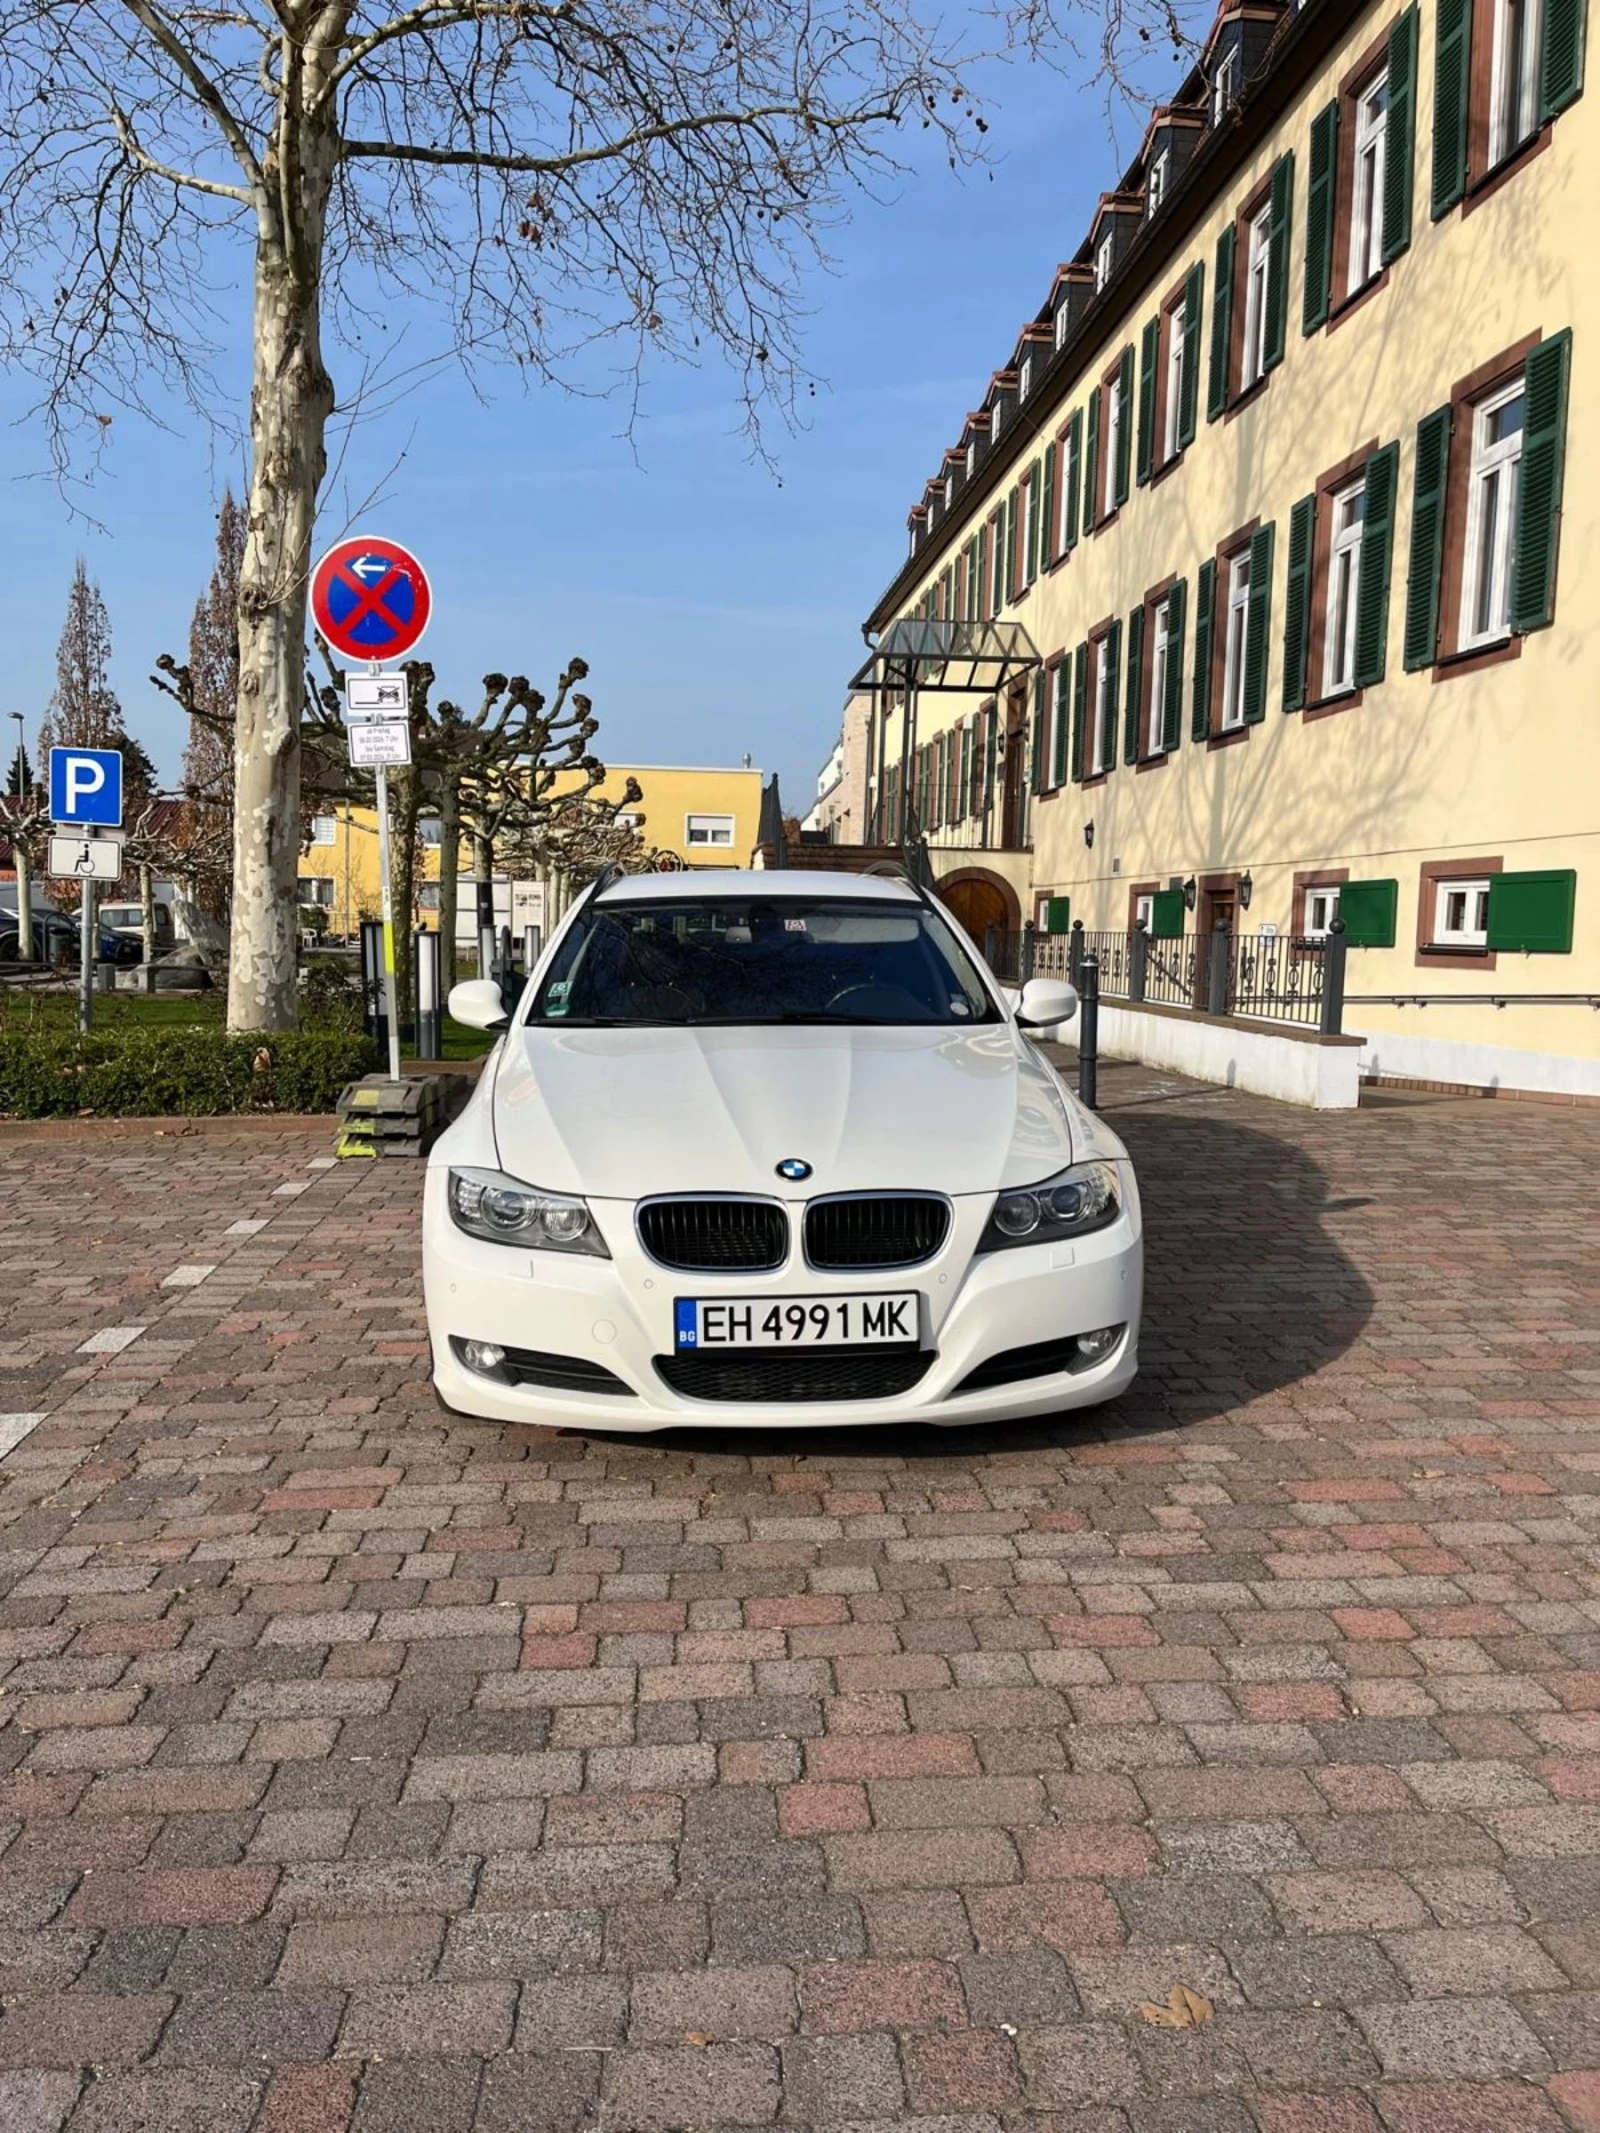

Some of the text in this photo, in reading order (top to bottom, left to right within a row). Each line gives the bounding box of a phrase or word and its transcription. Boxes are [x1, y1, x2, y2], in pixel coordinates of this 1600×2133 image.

[65, 757, 105, 814] P
[679, 1330, 696, 1342] BG
[703, 1301, 909, 1342] EH 4991 MK
